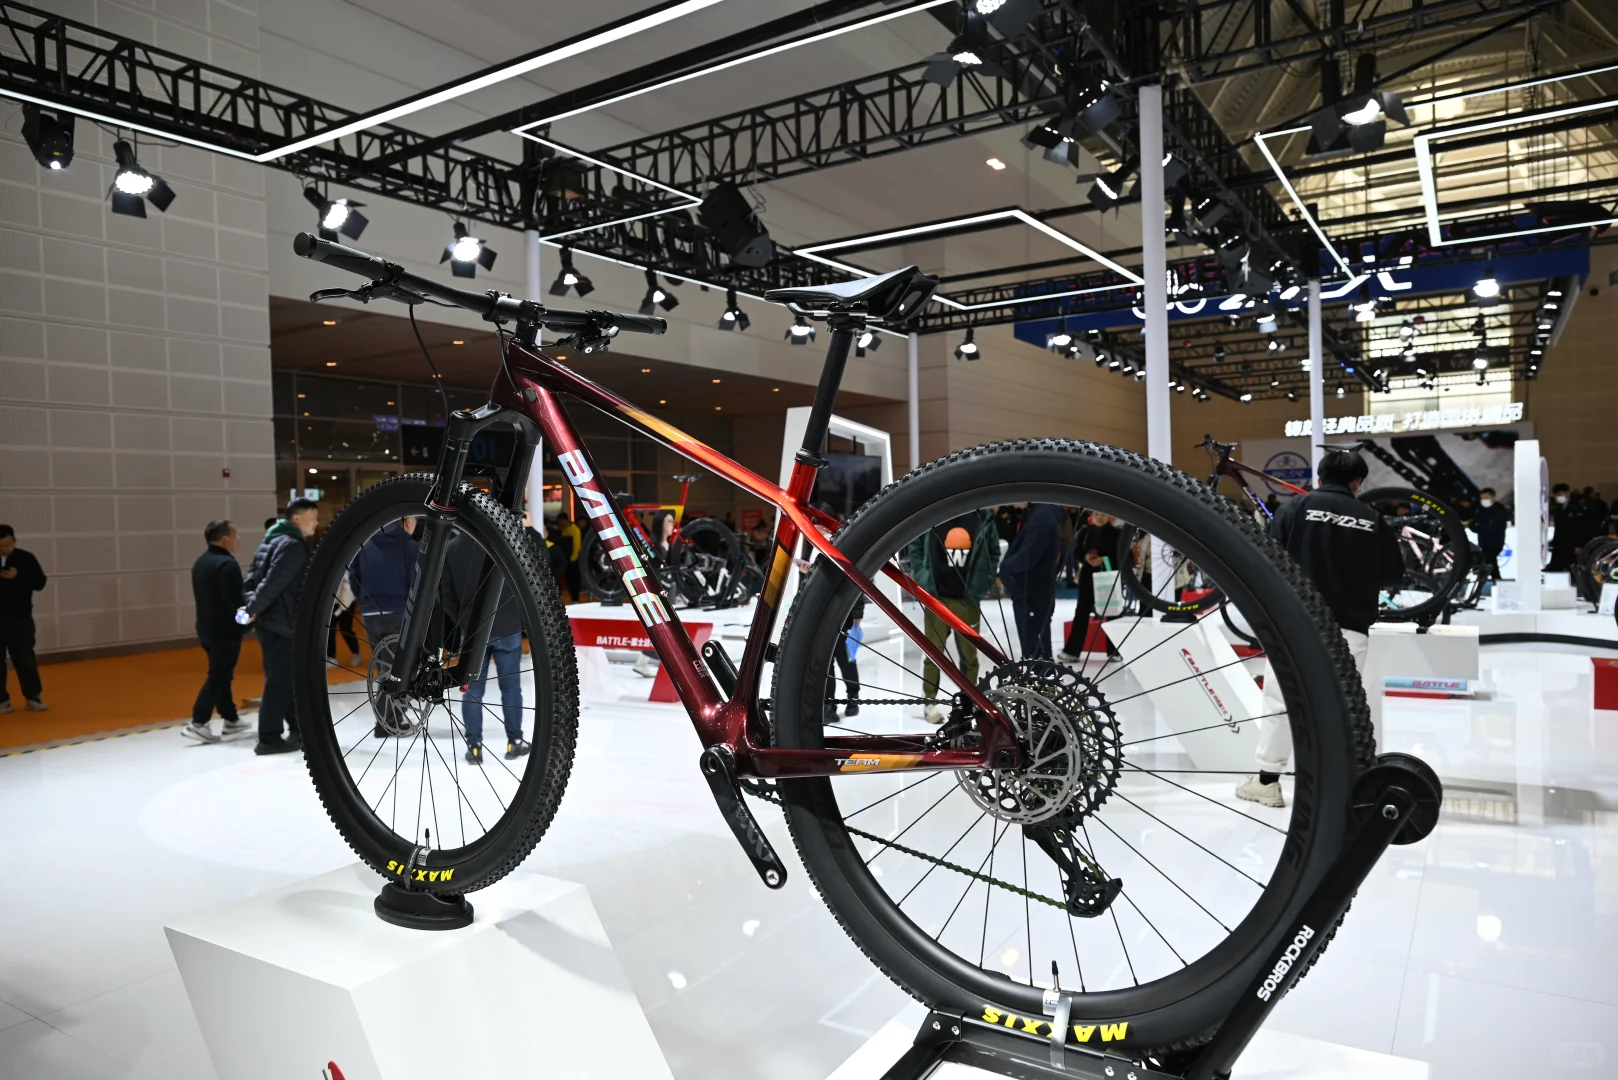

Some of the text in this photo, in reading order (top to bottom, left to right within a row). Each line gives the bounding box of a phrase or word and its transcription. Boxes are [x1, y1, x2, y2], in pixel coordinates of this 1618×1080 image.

[1410, 494, 1445, 515] MAXXIS
[558, 449, 671, 627] BATTLE
[1411, 680, 1461, 689] BATTLE
[834, 758, 881, 766] TEAM
[387, 860, 455, 882] MAXIS
[1256, 925, 1315, 1002] ROCKBROS
[981, 1006, 1129, 1042] MAXIS
